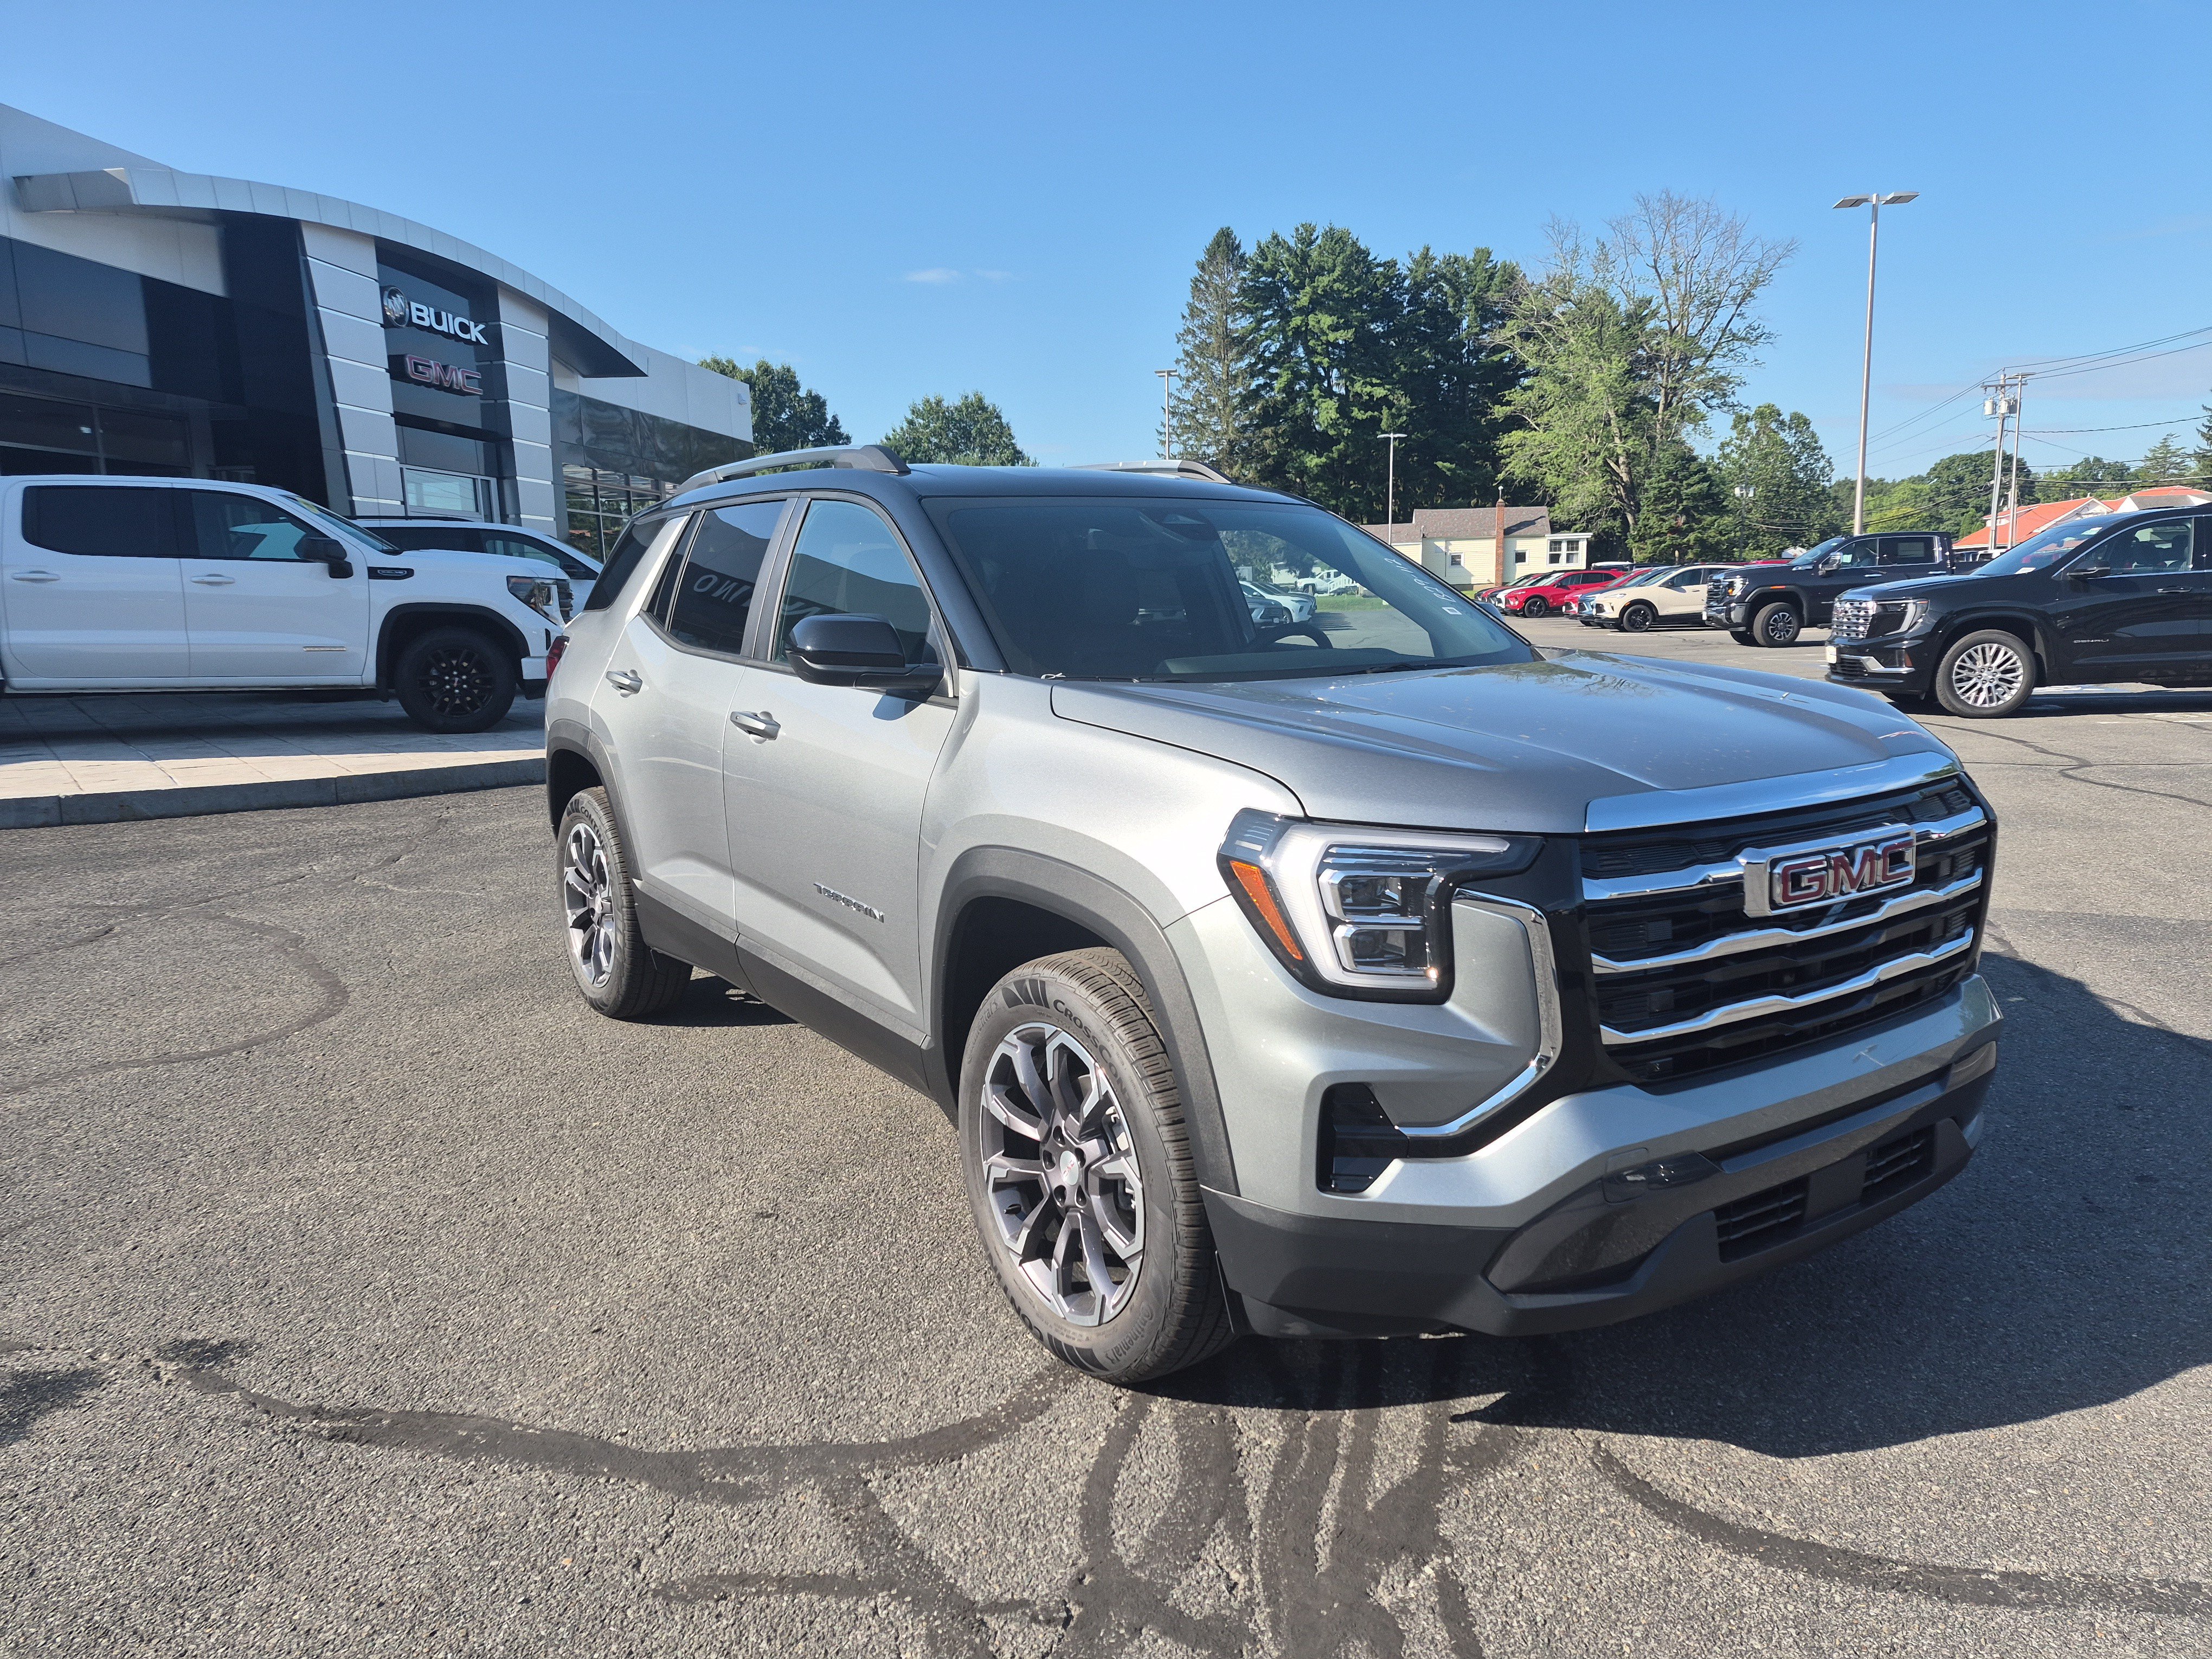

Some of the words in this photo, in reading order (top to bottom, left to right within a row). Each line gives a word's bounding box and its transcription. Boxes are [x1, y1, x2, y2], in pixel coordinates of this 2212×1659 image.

[410, 301, 488, 345] BUICK
[407, 354, 483, 395] GMC
[1773, 835, 1916, 906] GMC
[813, 882, 885, 923] TERRAIN
